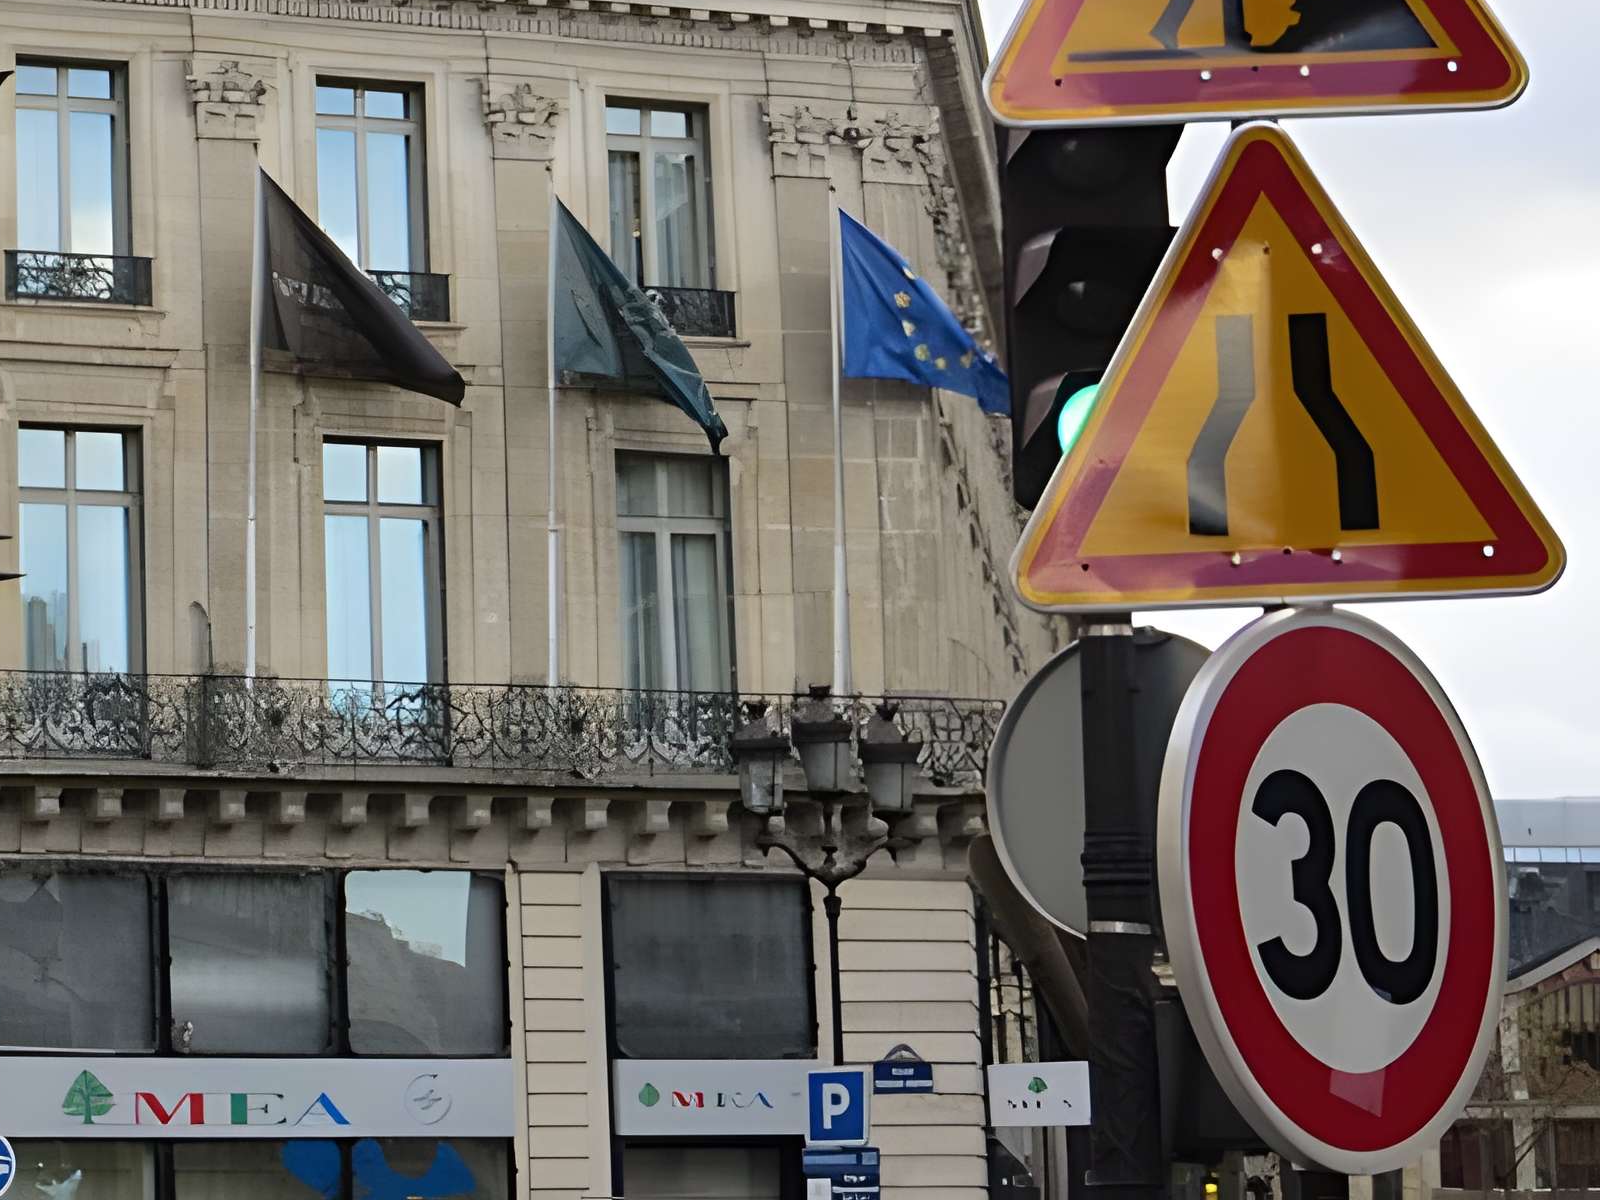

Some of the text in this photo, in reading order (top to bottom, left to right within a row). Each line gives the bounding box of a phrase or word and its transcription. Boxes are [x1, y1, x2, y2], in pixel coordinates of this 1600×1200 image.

[1251, 768, 1440, 1005] 30
[135, 1091, 352, 1126] MEA
[821, 1082, 851, 1130] P
